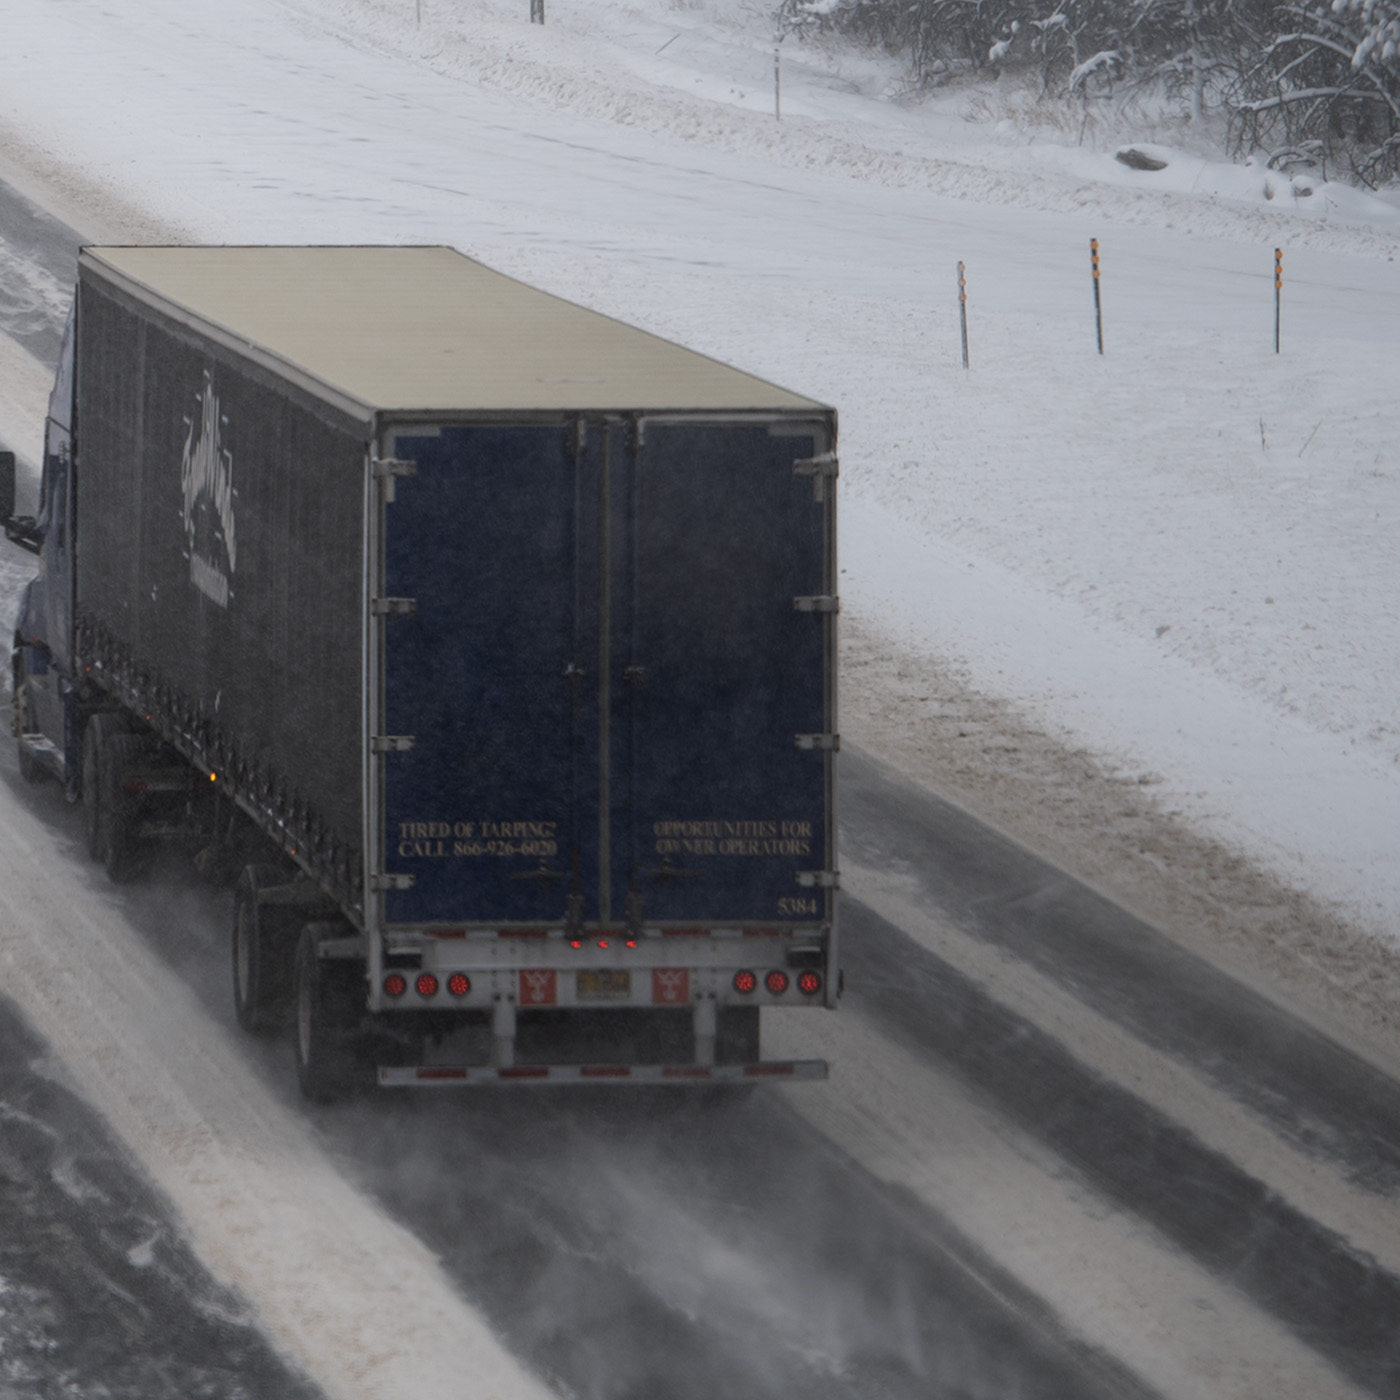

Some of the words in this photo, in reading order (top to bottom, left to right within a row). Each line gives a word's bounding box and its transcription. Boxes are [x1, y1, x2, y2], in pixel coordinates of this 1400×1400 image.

[399, 821, 451, 839] TIRED
[454, 821, 476, 838] OF
[480, 821, 557, 838] TARPING?
[653, 820, 777, 838] OPPORTUNITIES
[781, 820, 813, 838] FOR
[398, 840, 450, 857] CALL
[453, 840, 558, 857] 866-926-6020
[656, 839, 715, 856] OWNER
[719, 838, 810, 856] OPERATORS
[777, 897, 817, 916] 5384
